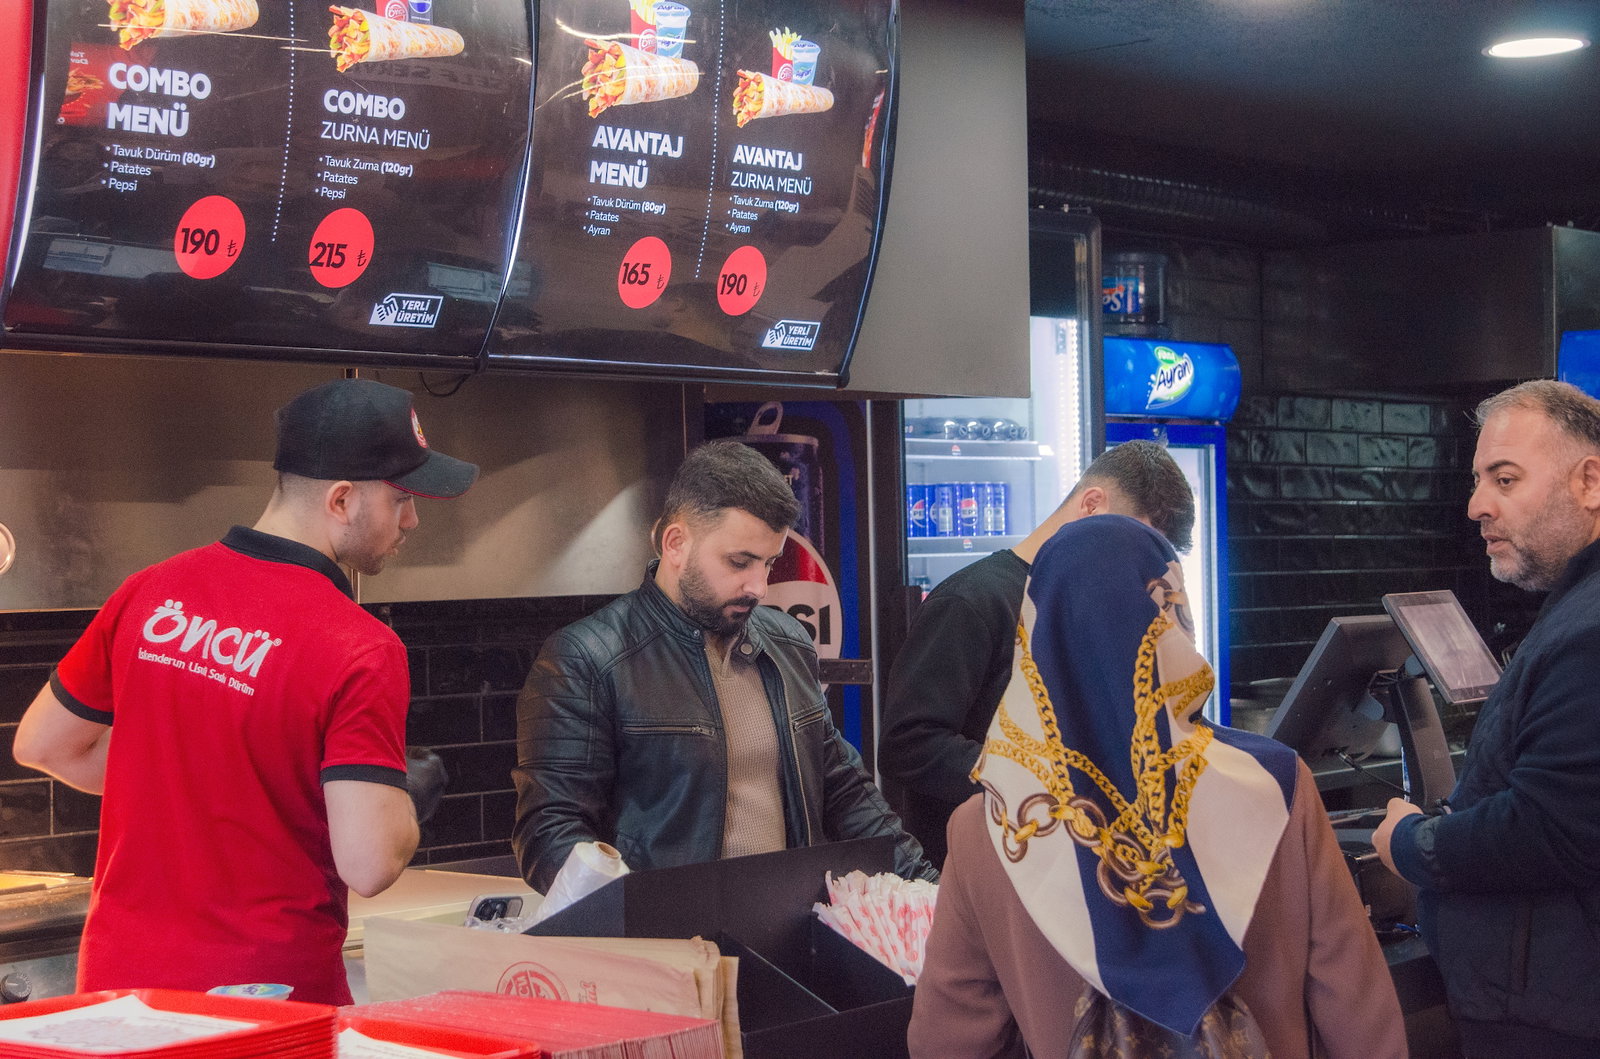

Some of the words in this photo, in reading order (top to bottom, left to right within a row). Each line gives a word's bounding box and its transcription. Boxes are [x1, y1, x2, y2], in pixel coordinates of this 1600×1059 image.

[109, 62, 212, 100] COMBO
[323, 89, 406, 120] COMBO
[107, 102, 190, 137] MENÜ
[321, 121, 380, 144] ZURNA
[383, 129, 431, 150] MENÜ
[592, 125, 684, 158] AVANTAJ
[112, 144, 143, 159] Tavuk
[145, 147, 181, 163] Dürüm
[182, 152, 216, 168] (80gr)
[325, 155, 351, 168] Tavuk
[353, 158, 379, 171] Zurna
[381, 162, 413, 177] (120gr)
[733, 144, 803, 171] AVANTAJ
[110, 161, 151, 176] Patates
[323, 171, 358, 185] Patates
[589, 159, 649, 189] MENÜ
[108, 177, 138, 192] Pepsi
[321, 186, 346, 200] Pepsi
[731, 171, 775, 191] ZURNA
[777, 177, 812, 195] MENÜ
[592, 196, 614, 208] Tavuk
[615, 198, 641, 210] Dürüm
[642, 201, 666, 215] (80gr)
[732, 209, 758, 220] Patates
[733, 195, 753, 206] Tavuk
[775, 200, 799, 213] (120gr)
[590, 210, 619, 222] Patates
[587, 224, 611, 236] Ayran
[730, 222, 750, 234] Ayran
[181, 227, 220, 255] 190
[309, 241, 348, 269] 215
[622, 263, 651, 285] 165
[720, 273, 747, 296] 190
[402, 299, 431, 311] YERLİ
[397, 311, 434, 324] ÜRETİM
[783, 334, 812, 346] ÜRETİM
[788, 325, 811, 335] YERLİ
[1156, 361, 1191, 391] Ayran
[138, 647, 186, 669] İskenderun
[228, 677, 255, 696] Dürüm
